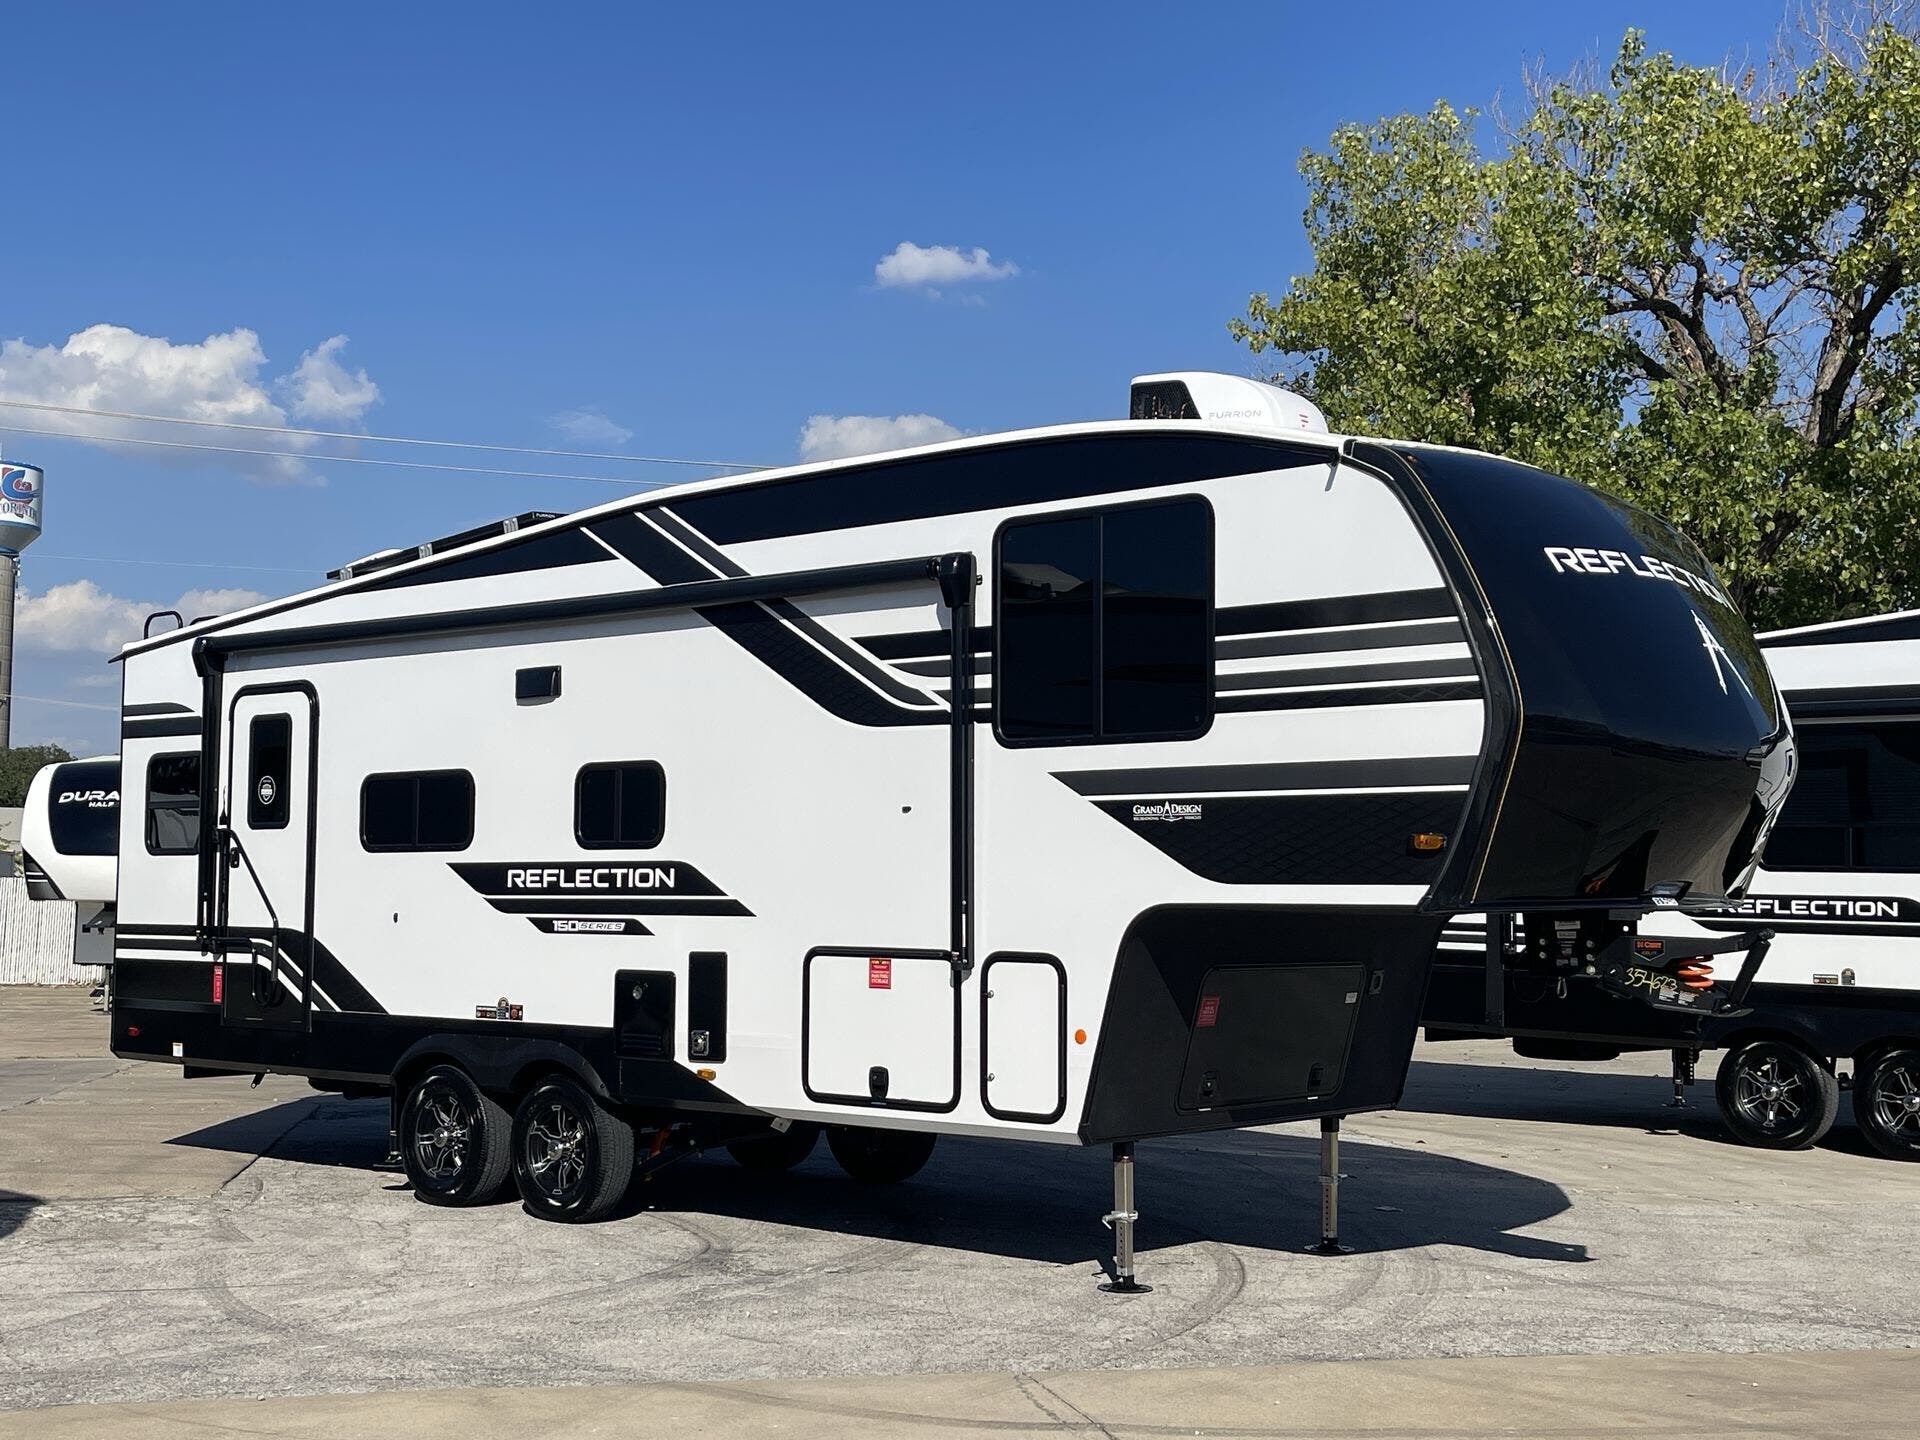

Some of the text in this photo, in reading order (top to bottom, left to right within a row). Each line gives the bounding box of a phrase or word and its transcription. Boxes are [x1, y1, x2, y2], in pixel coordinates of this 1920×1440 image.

[1208, 409, 1262, 420] FURRION
[1543, 546, 1738, 615] REFLECTION
[1132, 803, 1203, 814] GRAND DESIGN
[506, 867, 676, 889] REFLECTION
[552, 920, 625, 932] 150 SERIES
